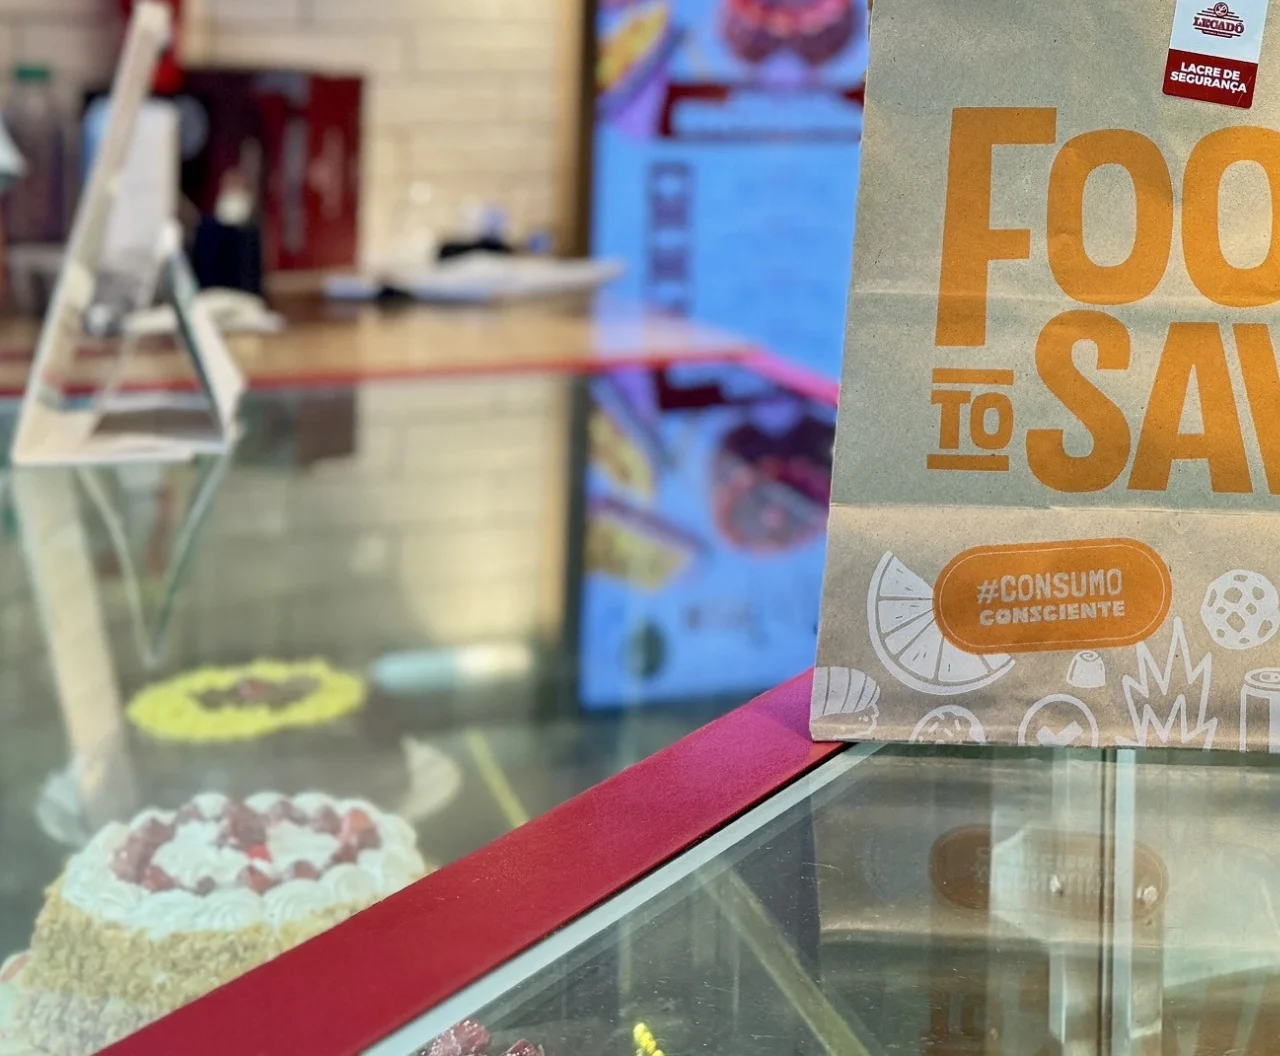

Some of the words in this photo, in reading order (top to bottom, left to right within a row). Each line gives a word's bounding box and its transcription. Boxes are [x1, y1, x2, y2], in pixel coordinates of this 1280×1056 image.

[1170, 72, 1247, 93] SEGURANÇA
[1180, 62, 1220, 77] LACRE
[1223, 69, 1240, 81] DE
[929, 389, 1014, 451] TO
[976, 567, 1123, 605] #CONSUMO
[979, 600, 1126, 626] CONSCIENTE
